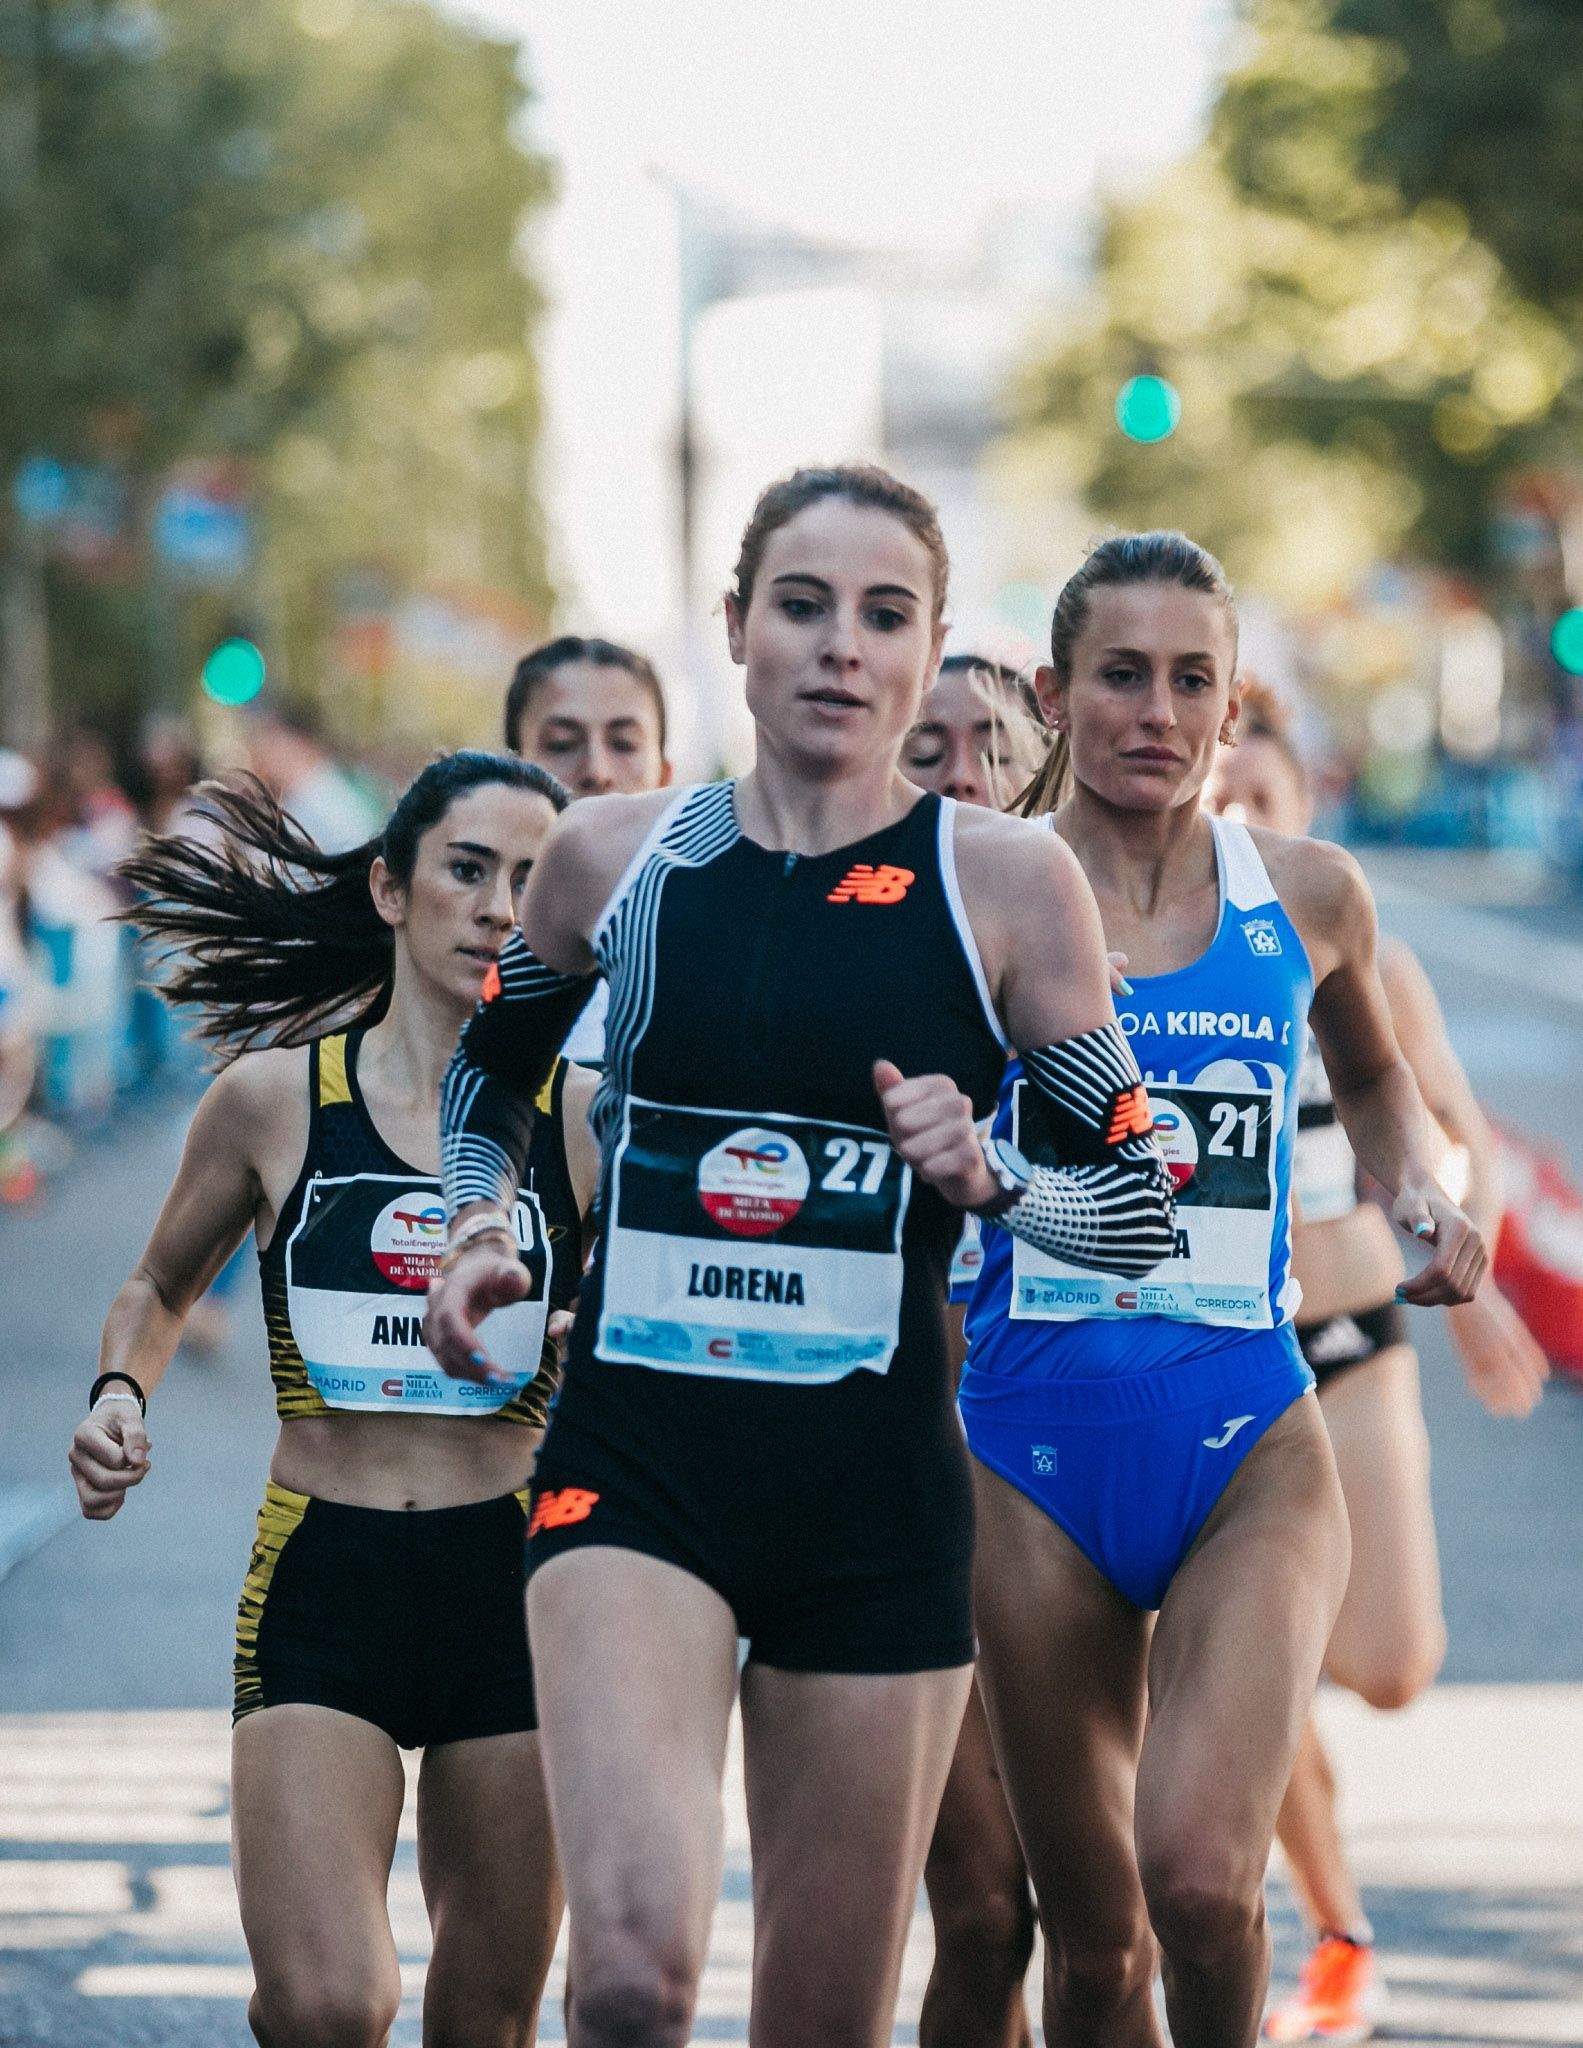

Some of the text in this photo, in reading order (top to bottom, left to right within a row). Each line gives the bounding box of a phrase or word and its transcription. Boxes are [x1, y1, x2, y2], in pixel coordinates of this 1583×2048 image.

[1167, 1011, 1274, 1042] KIROLA
[1208, 1102, 1259, 1158] 21
[821, 1137, 891, 1194] 27
[512, 1201, 534, 1251] 0
[390, 1266, 404, 1276] DE
[403, 1256, 435, 1267] MILLA
[688, 1263, 805, 1306] LORENA
[1044, 1290, 1100, 1305] MADRID
[371, 1315, 428, 1347] ANN
[314, 1375, 366, 1392] MADRID
[405, 1379, 439, 1390] MILLA
